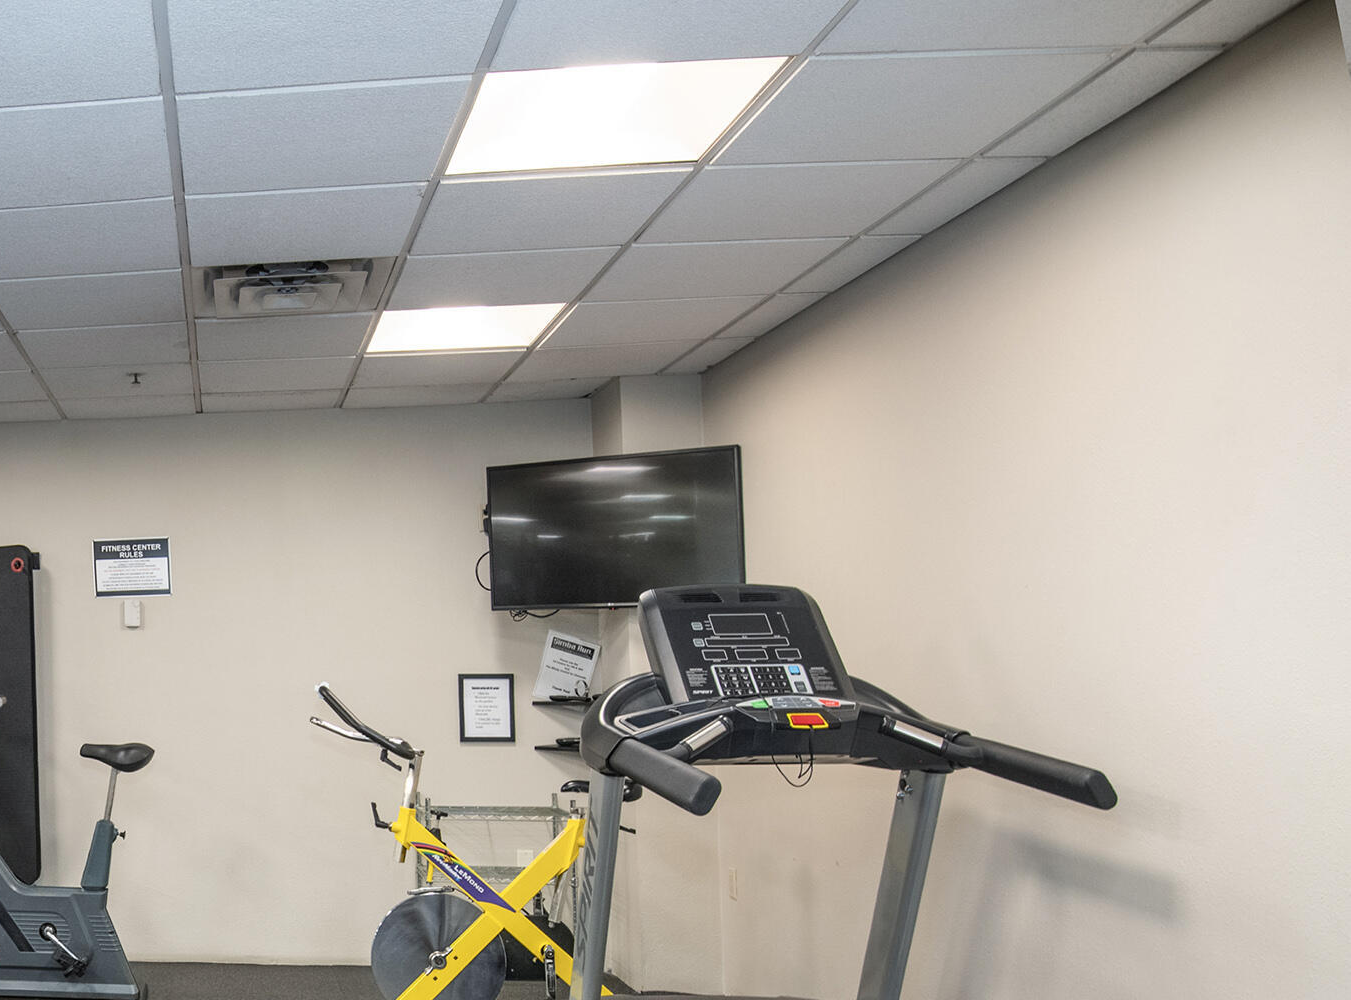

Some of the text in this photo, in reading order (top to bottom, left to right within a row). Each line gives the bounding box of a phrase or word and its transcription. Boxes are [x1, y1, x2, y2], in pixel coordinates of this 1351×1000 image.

[101, 543, 162, 553] FITNESS CENTER
[119, 551, 144, 559] RULES
